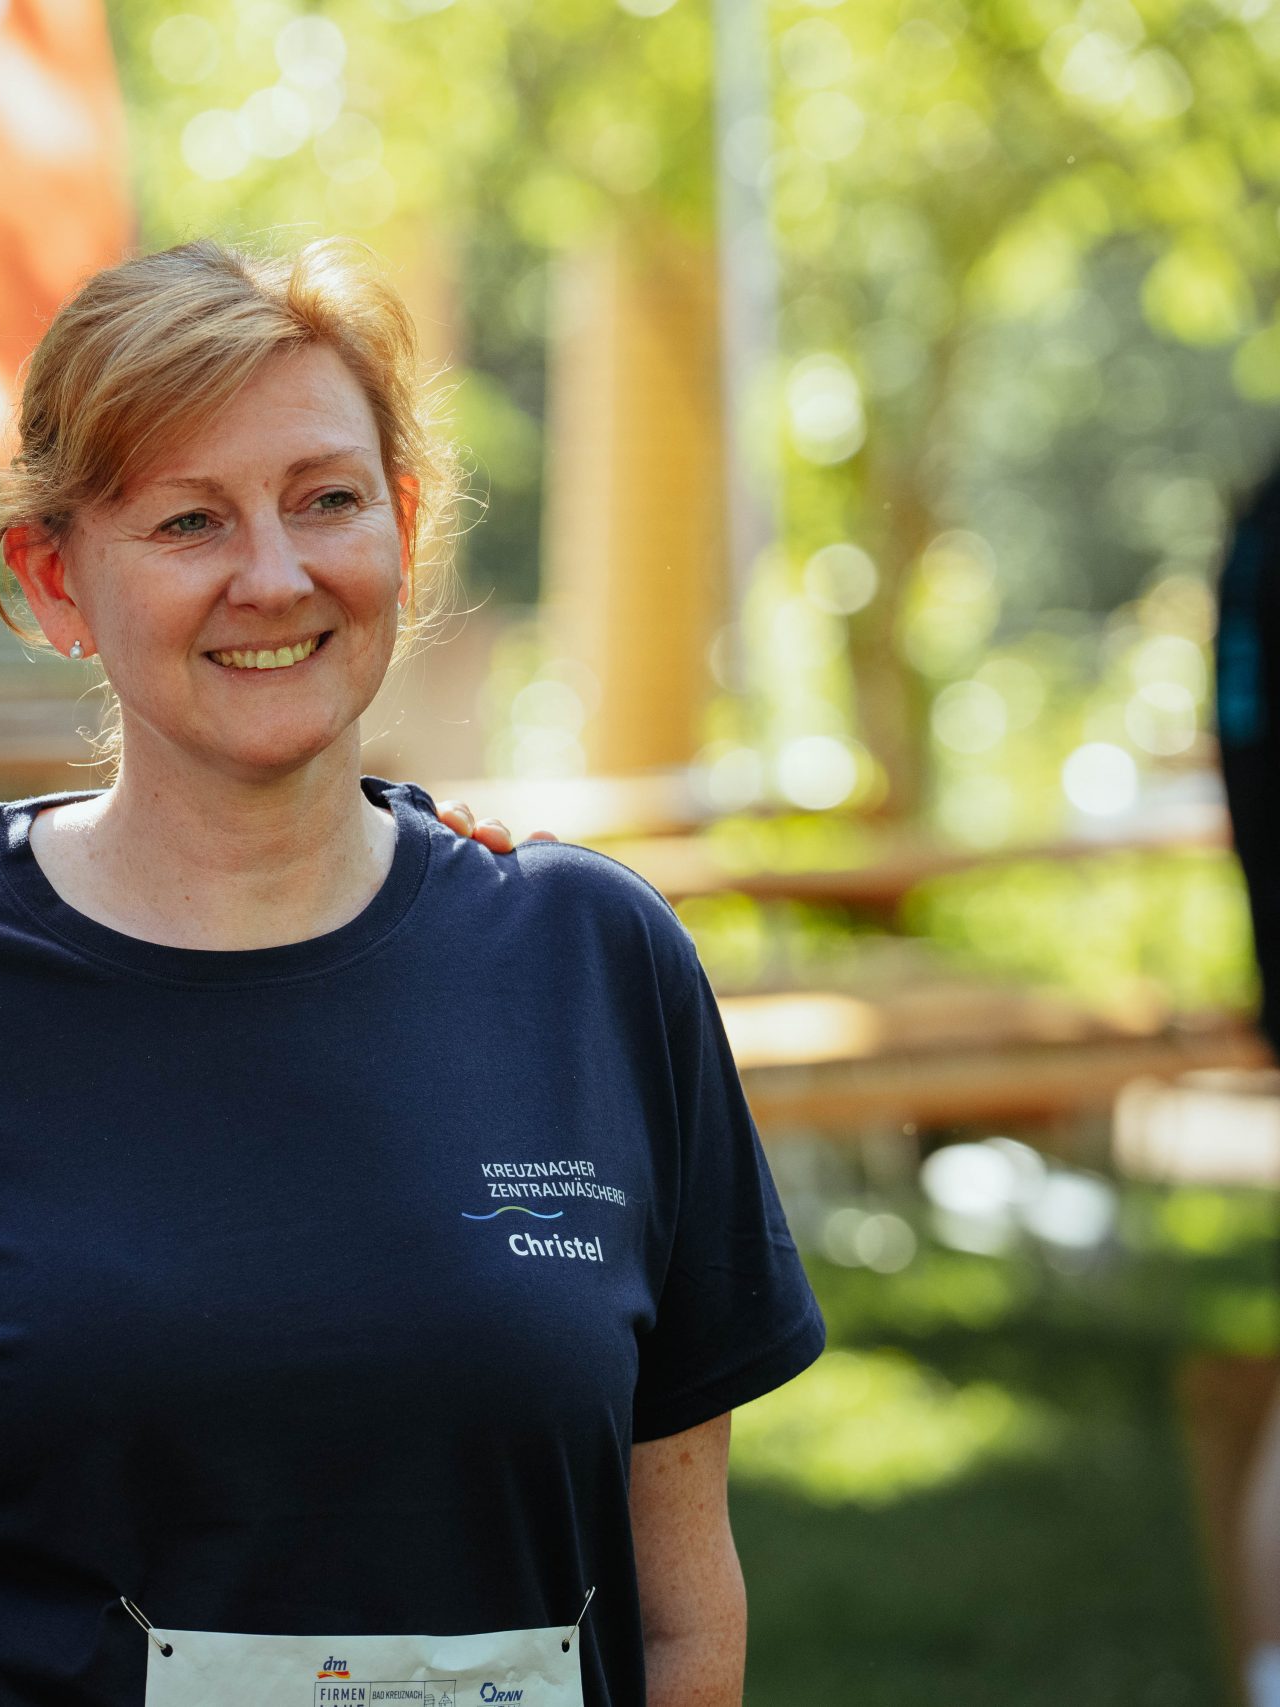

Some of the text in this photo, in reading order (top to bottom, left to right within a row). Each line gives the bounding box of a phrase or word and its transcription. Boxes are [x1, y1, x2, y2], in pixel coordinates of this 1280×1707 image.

[481, 1160, 596, 1178] KREUZNACHER
[487, 1178, 626, 1207] ZENTRALWÄSCHEREI
[508, 1232, 604, 1262] Christel
[323, 1656, 347, 1671] dm
[320, 1688, 365, 1701] FIRMEN
[372, 1690, 423, 1700] BAD KREUZNACH
